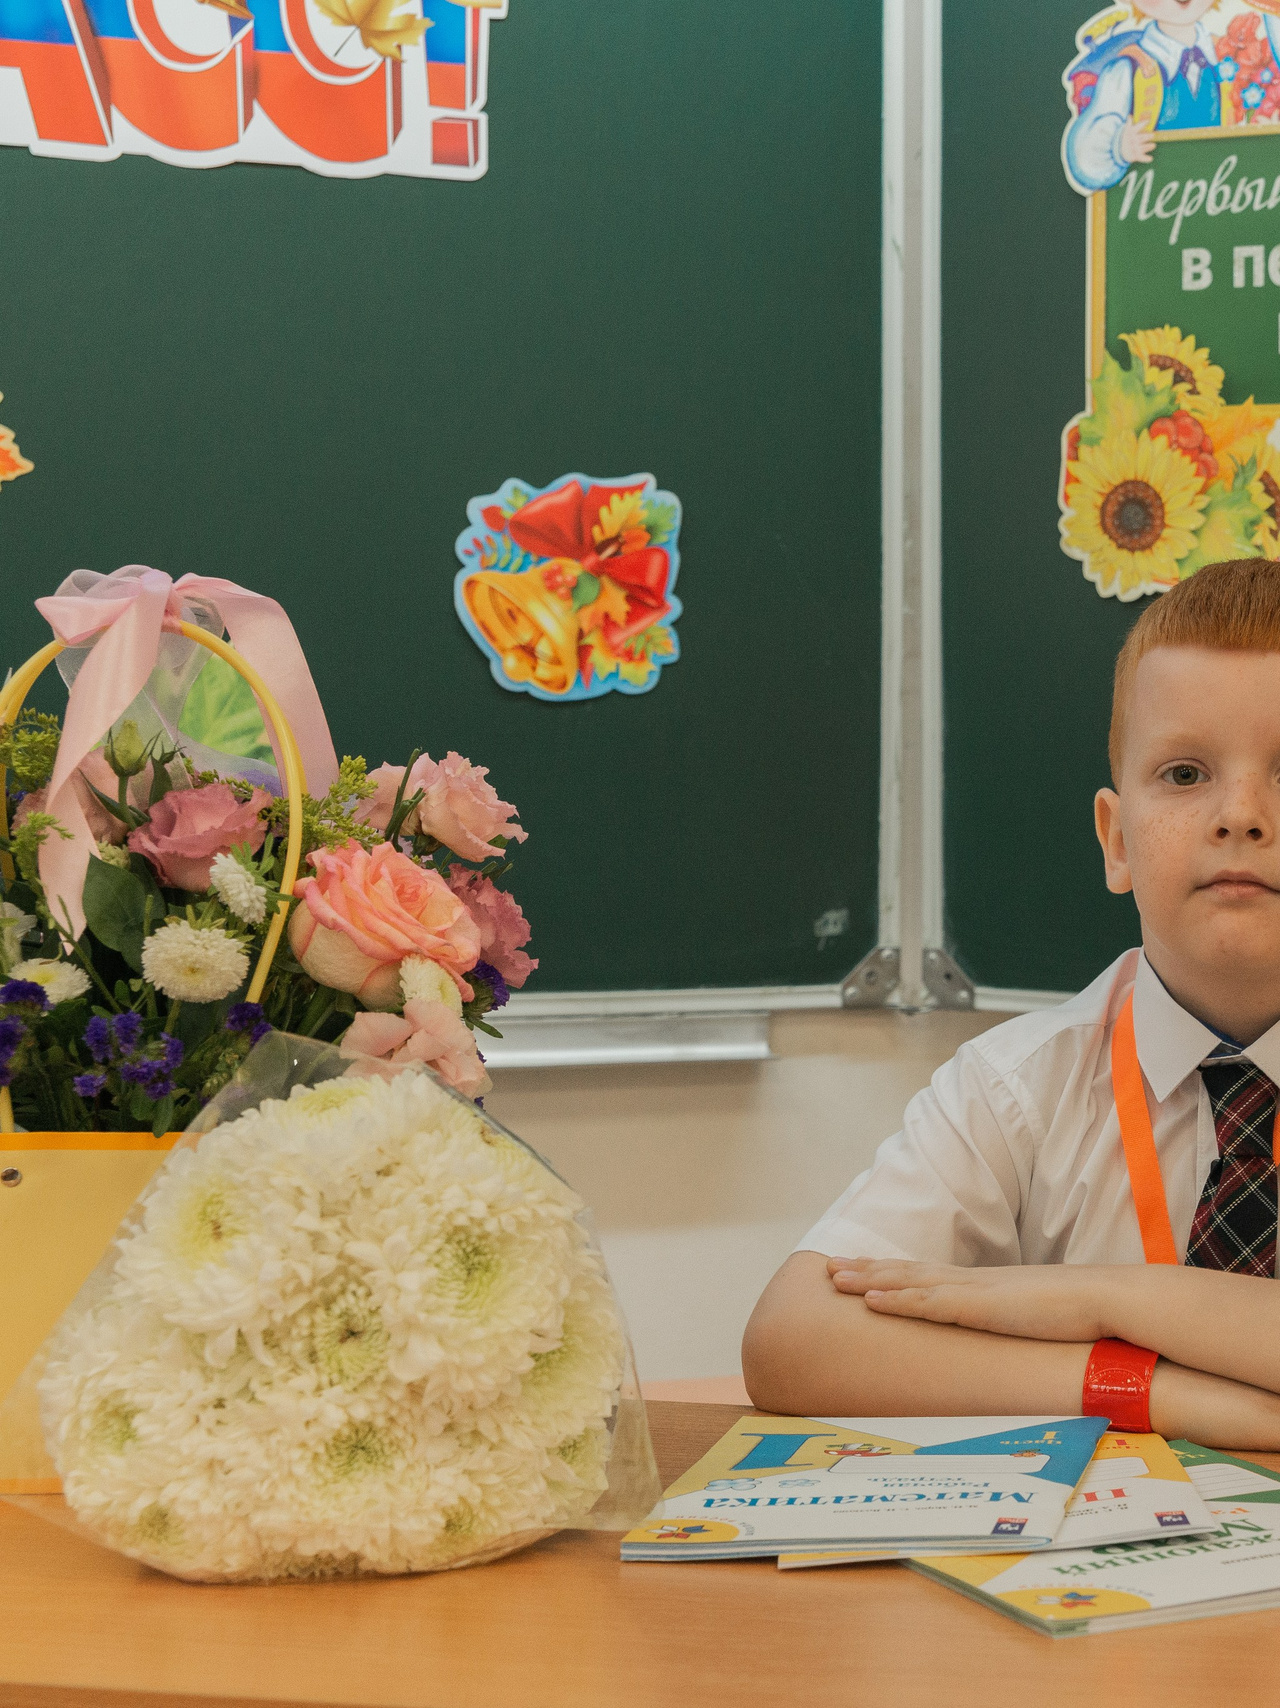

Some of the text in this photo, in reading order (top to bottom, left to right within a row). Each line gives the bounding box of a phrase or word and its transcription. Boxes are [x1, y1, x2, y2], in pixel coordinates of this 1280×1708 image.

[1181, 247, 1213, 291] в
[729, 1433, 838, 1472] 1
[701, 1491, 1039, 1510] Математика
